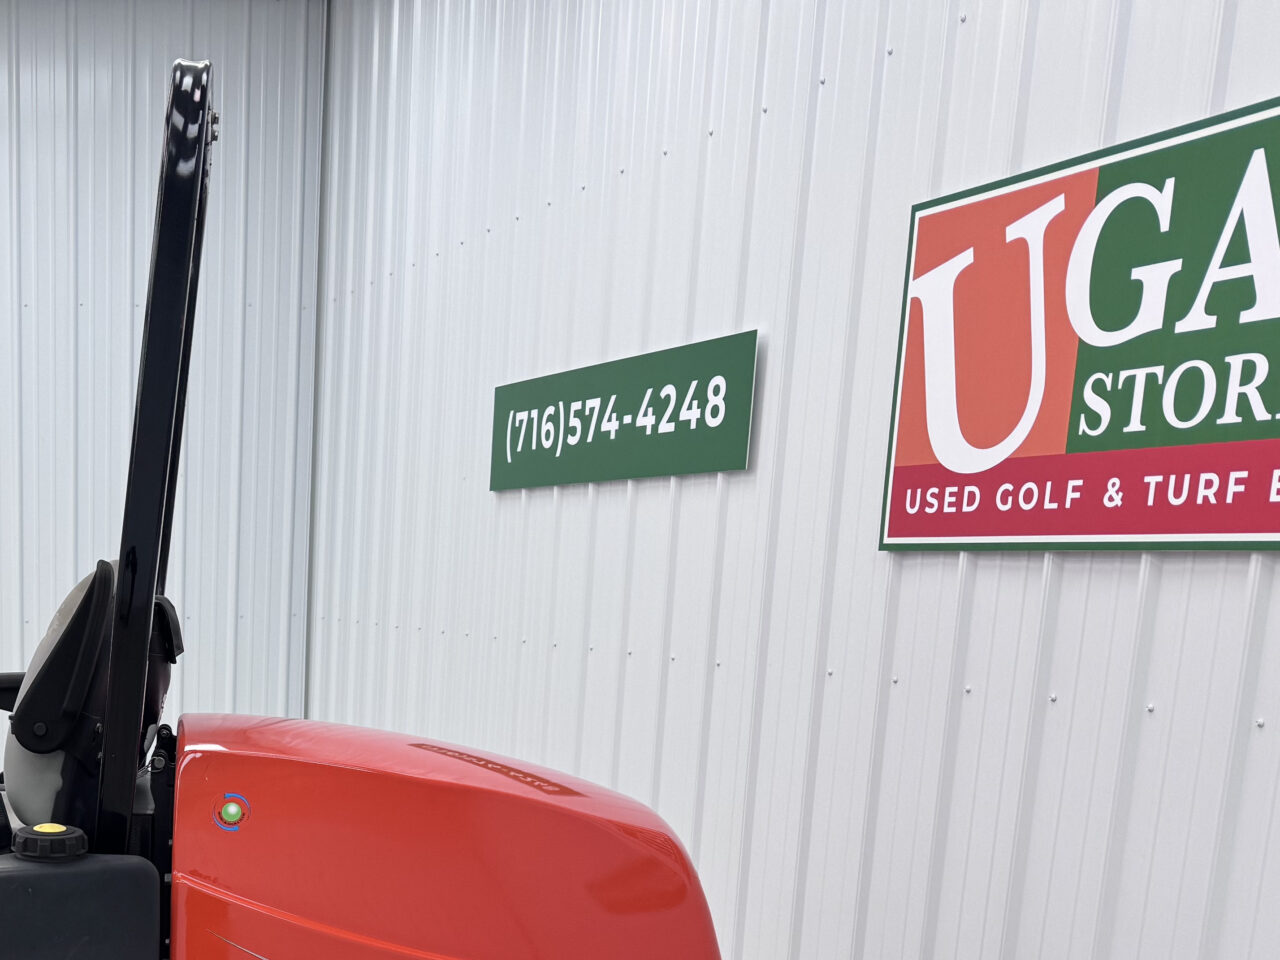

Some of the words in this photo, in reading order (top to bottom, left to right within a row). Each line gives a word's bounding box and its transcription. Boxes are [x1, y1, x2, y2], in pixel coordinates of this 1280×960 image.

[506, 375, 727, 463] (716)574-4248
[1078, 352, 1280, 436] STOR
[905, 485, 981, 514] USED
[995, 479, 1084, 511] GOLF
[1103, 477, 1124, 507] &
[1144, 470, 1249, 506] TURF
